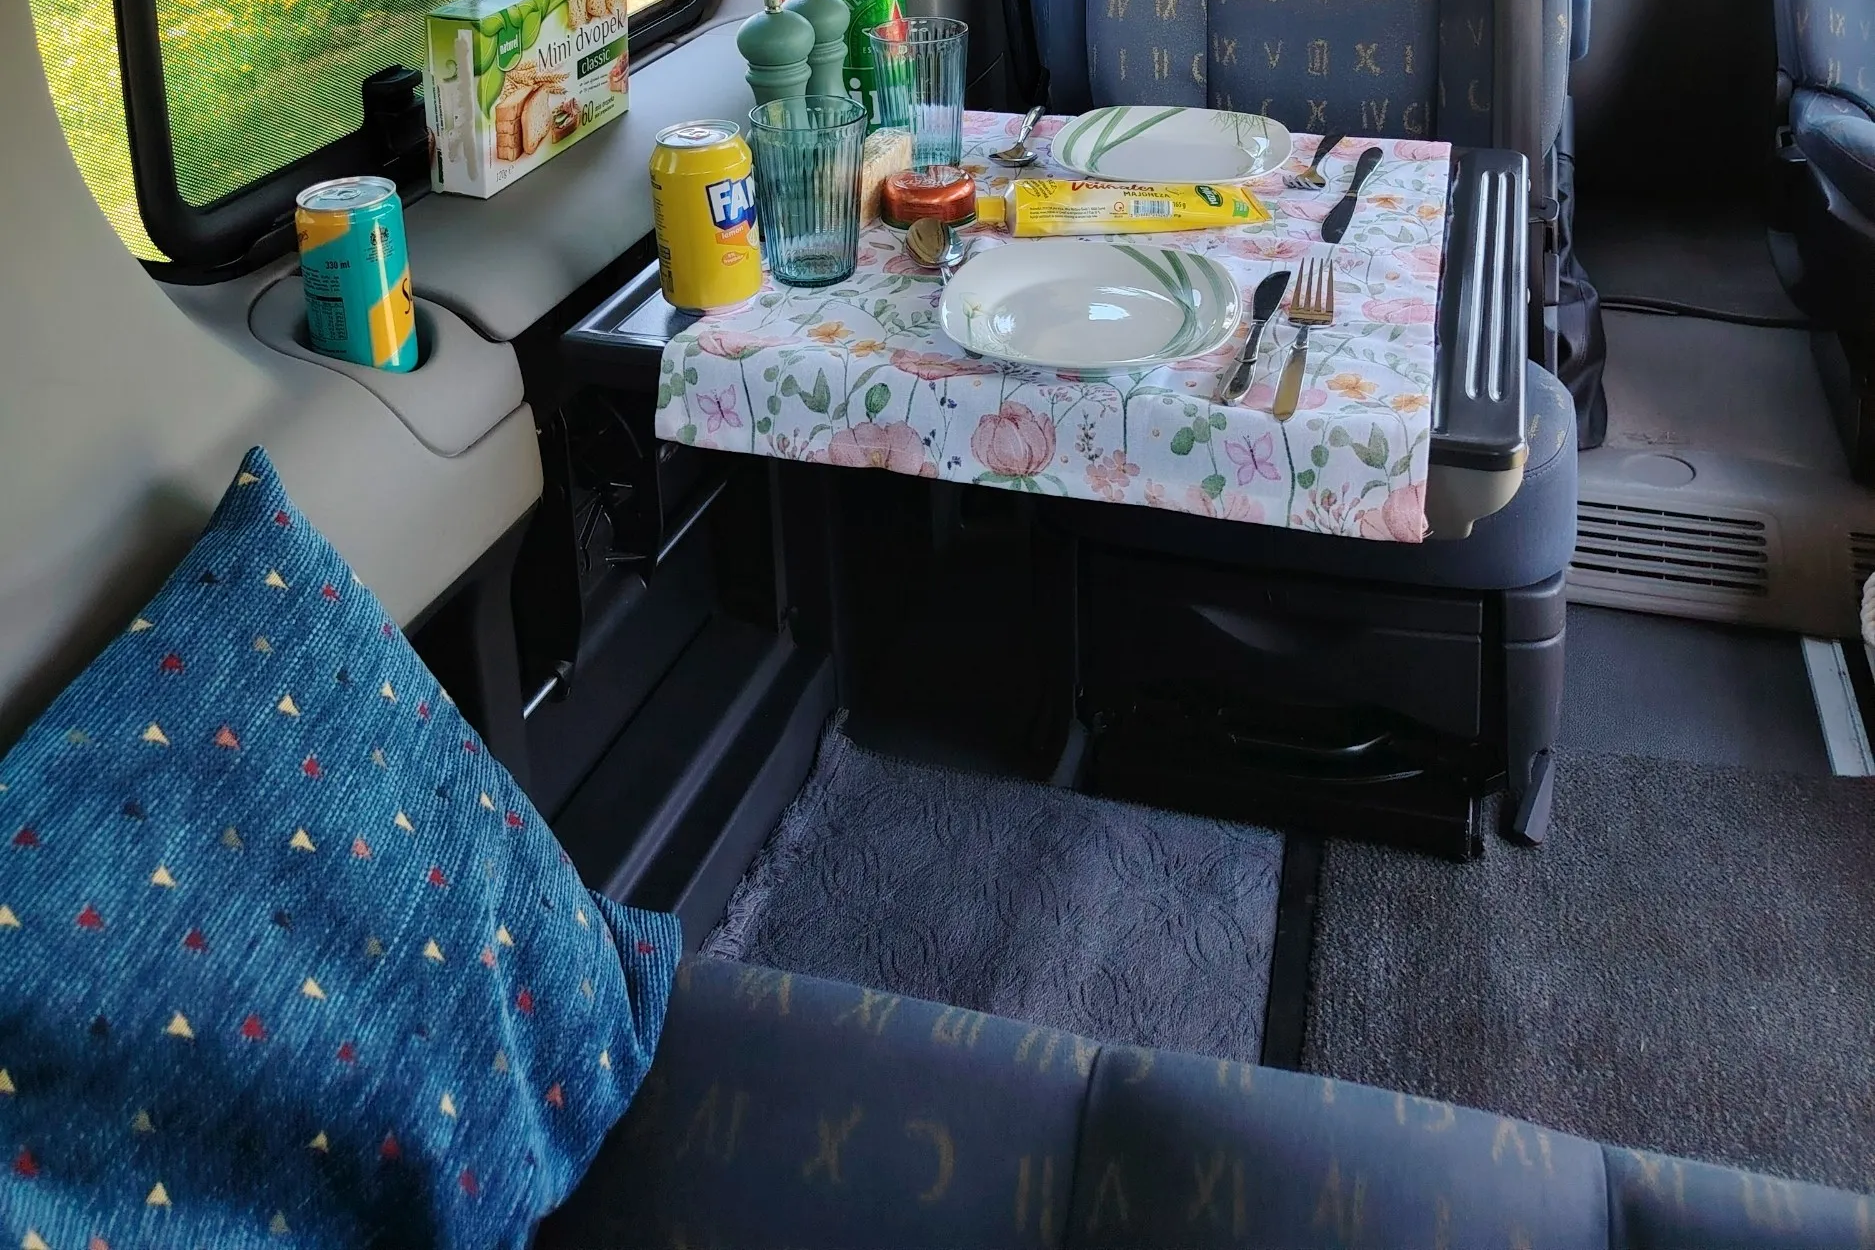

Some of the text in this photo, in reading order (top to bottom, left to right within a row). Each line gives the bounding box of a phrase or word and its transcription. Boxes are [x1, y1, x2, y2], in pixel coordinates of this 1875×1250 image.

[538, 8, 625, 70] Mini dvopek
[581, 49, 611, 75] classic
[581, 100, 594, 127] 60
[1123, 190, 1171, 199] MAJONEZA
[721, 225, 744, 240] lemon
[325, 260, 339, 270] 330
